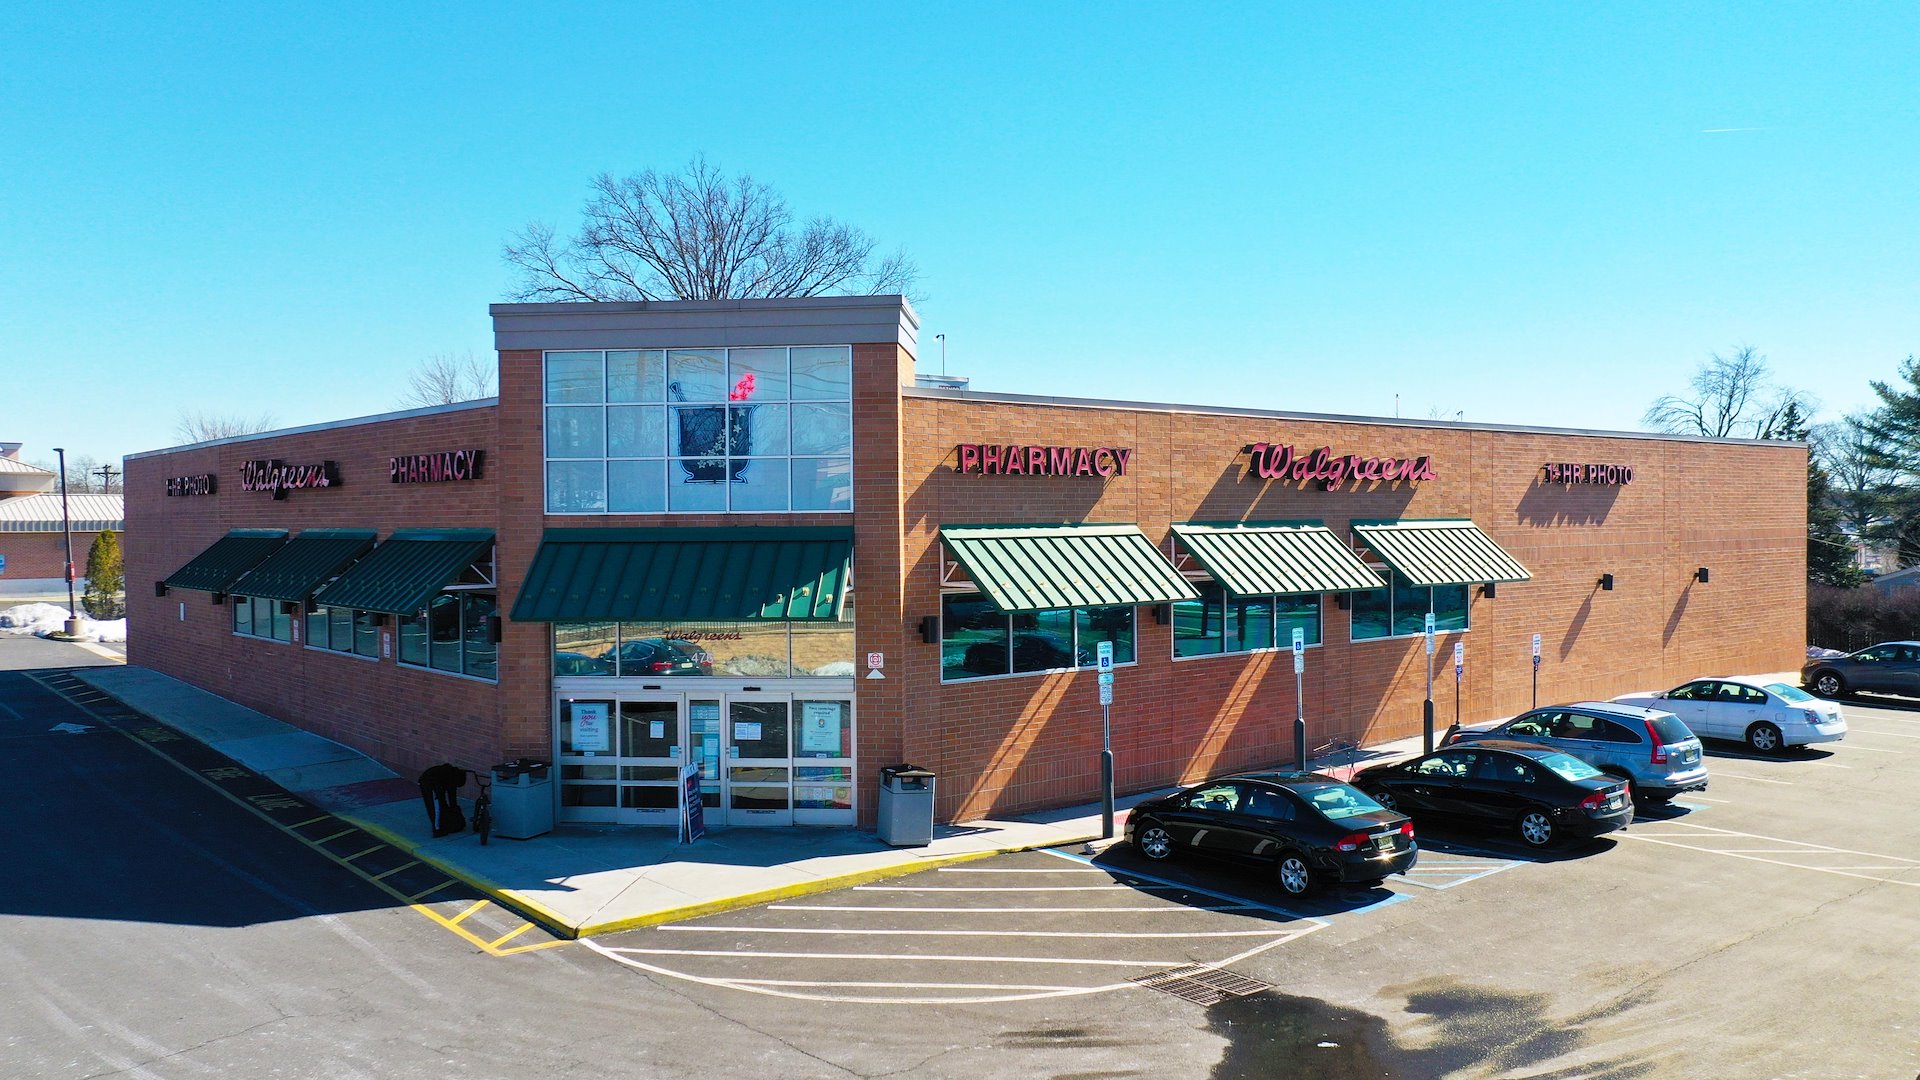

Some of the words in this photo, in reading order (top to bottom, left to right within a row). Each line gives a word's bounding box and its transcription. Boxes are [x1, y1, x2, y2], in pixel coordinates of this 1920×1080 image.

[389, 449, 476, 483] PHARMACY
[958, 444, 1132, 477] PHARMACY
[1247, 442, 1437, 492] Walgreens
[1545, 463, 1582, 484] 1-HR
[1589, 464, 1634, 486] PHOTO
[184, 474, 210, 496] PHOTO
[240, 459, 330, 501] Walgreens
[663, 630, 743, 644] Walgreens
